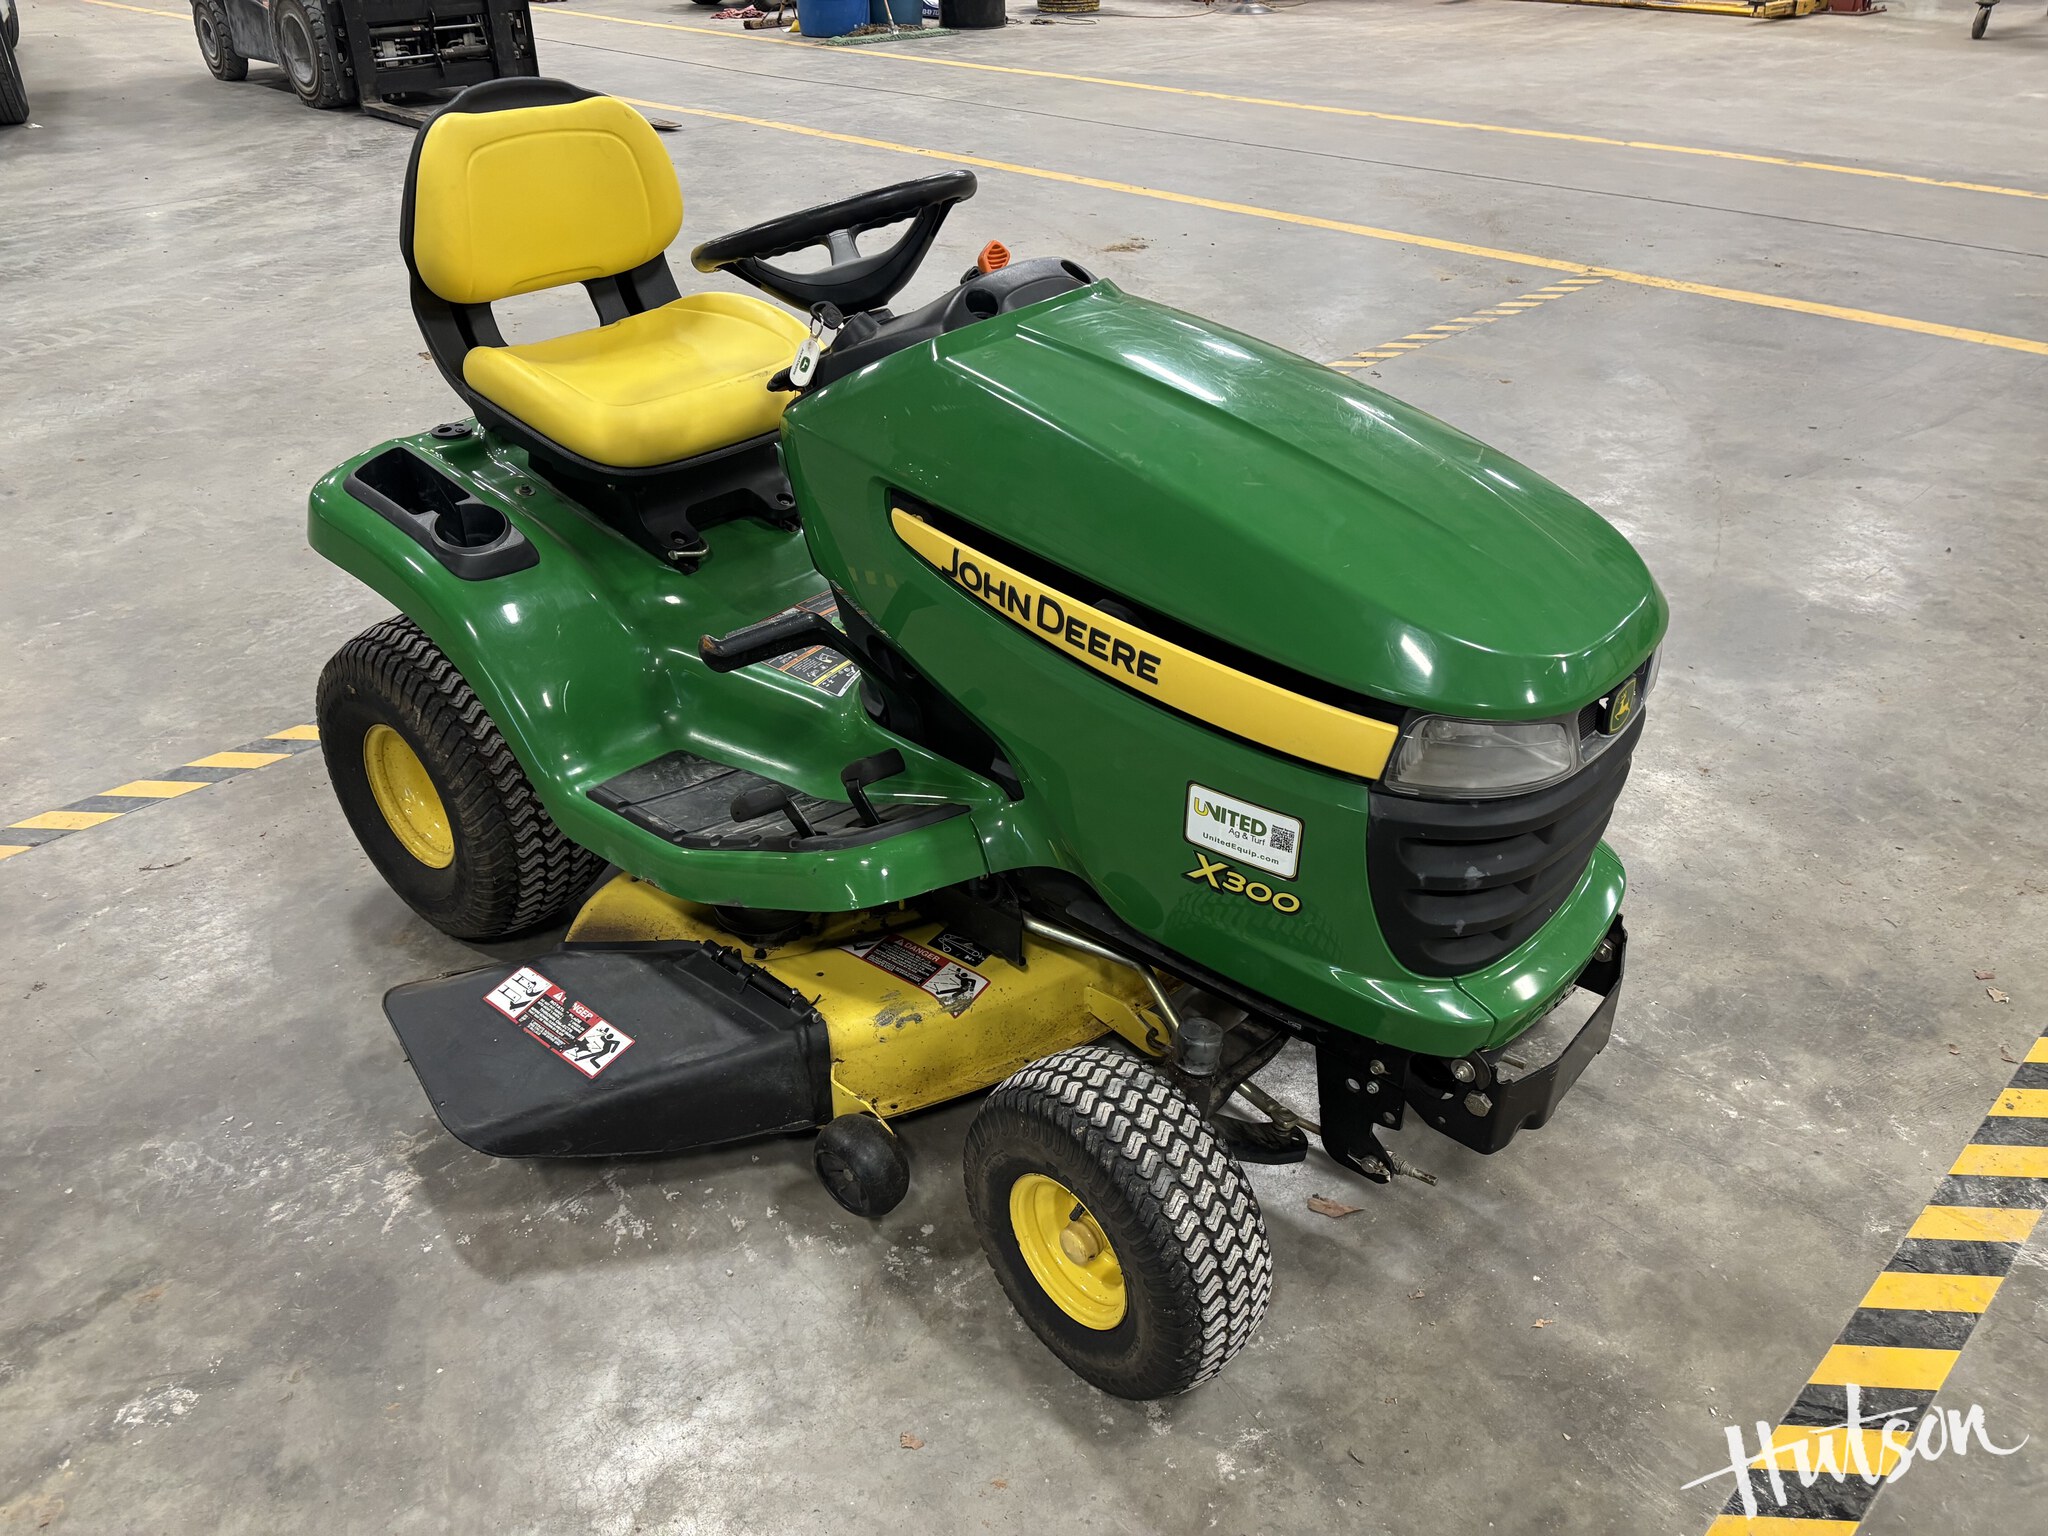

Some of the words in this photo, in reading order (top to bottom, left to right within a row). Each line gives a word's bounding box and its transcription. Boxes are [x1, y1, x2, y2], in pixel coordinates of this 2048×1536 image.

[941, 547, 1031, 621] JOHN
[1037, 595, 1161, 685] DEERE
[1193, 796, 1268, 837] UNITED
[1202, 831, 1279, 865] UnitedEquip.com
[1228, 827, 1241, 839] Ag
[1242, 831, 1249, 841] &
[1250, 834, 1266, 846] Turf
[1185, 851, 1301, 914] X300
[904, 942, 941, 962] DANGER
